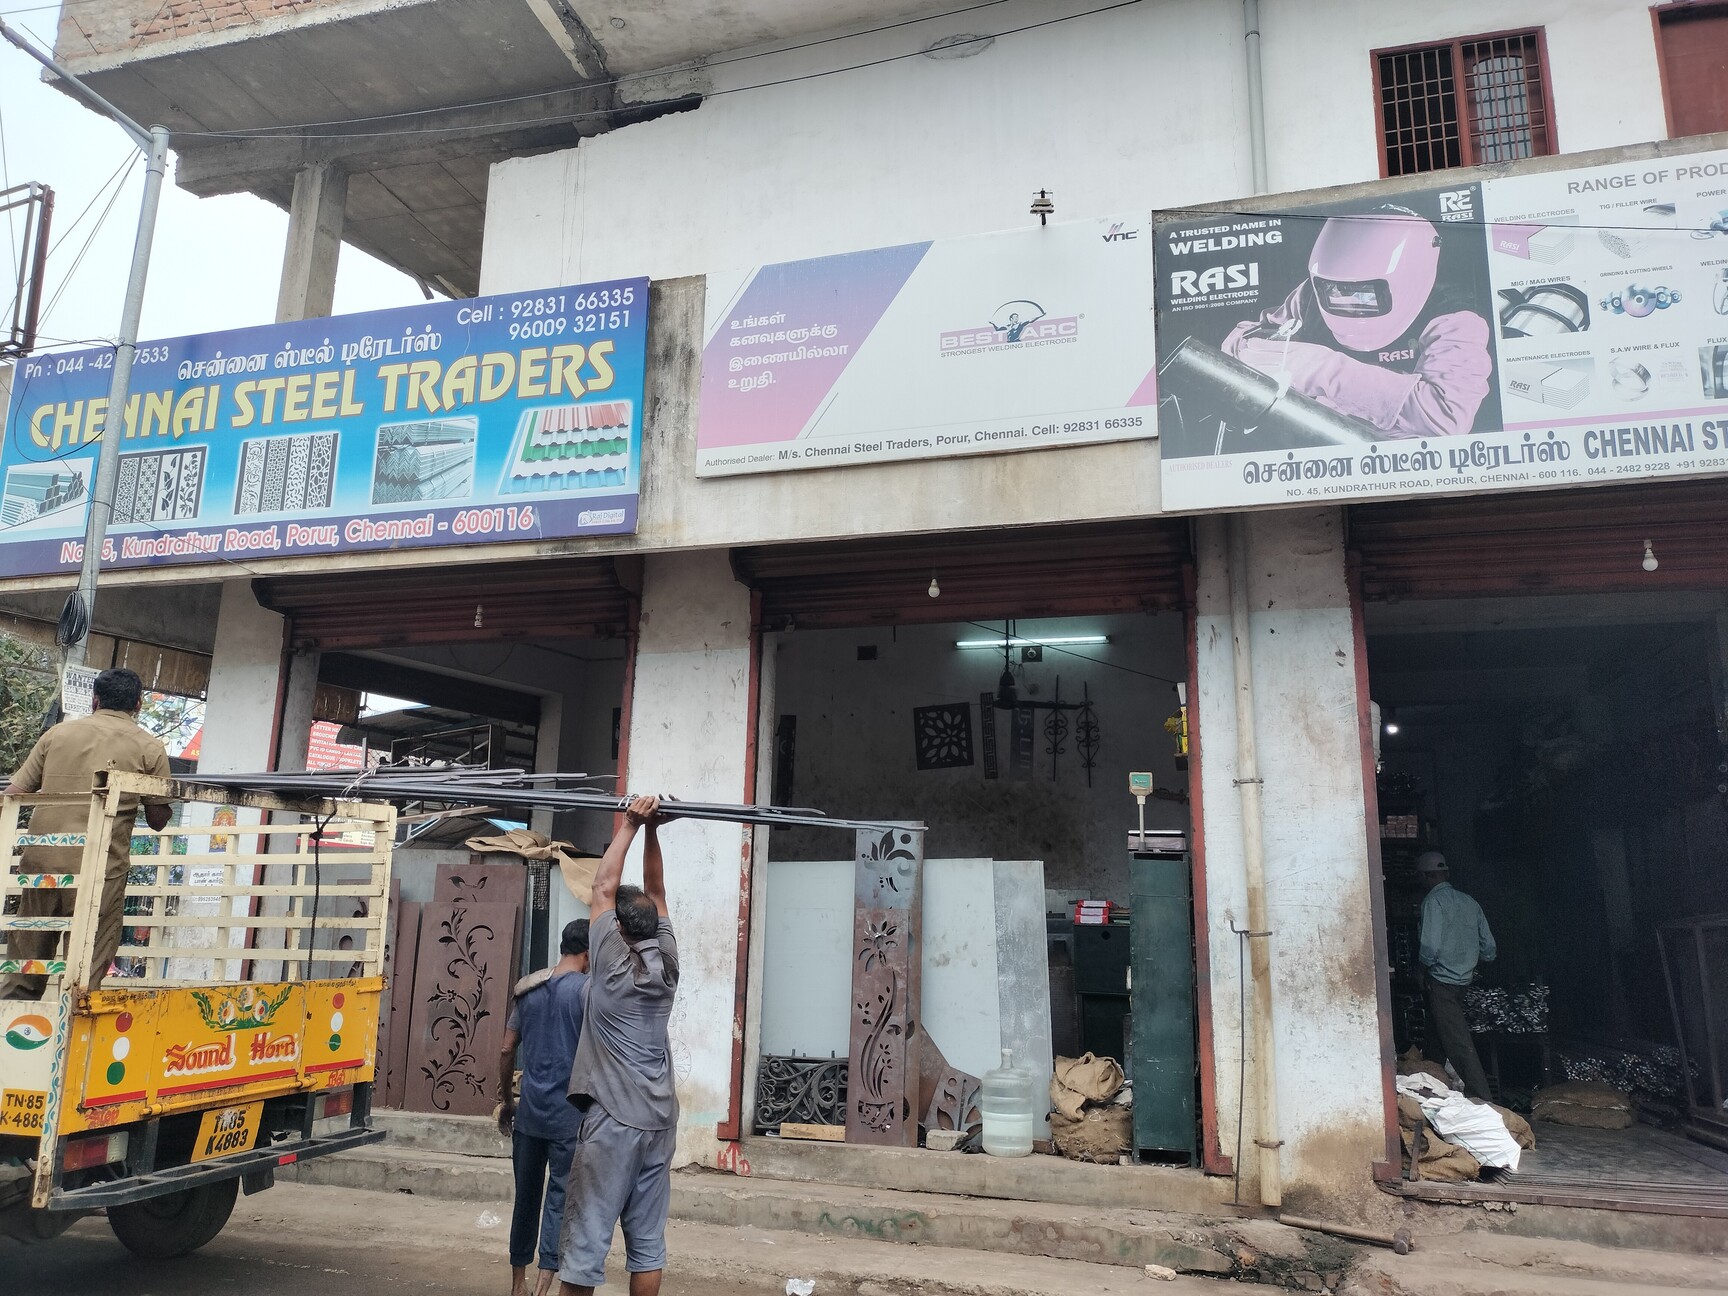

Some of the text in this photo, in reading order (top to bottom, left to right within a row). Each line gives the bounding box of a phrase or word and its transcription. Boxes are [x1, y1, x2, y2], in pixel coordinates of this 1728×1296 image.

[1567, 175, 1636, 195] RANGE
[1642, 170, 1669, 185] OF
[1615, 200, 1639, 209] FILLER
[1639, 198, 1658, 206] WIRE
[1696, 189, 1727, 198] POWER
[1493, 208, 1575, 223] WELDING ELECTRODES
[1169, 231, 1178, 239] A
[1179, 225, 1230, 238] TRUSTED
[1232, 220, 1266, 231] NAME
[1169, 231, 1283, 256] WELDING
[1500, 240, 1520, 251] RASI
[1599, 270, 1625, 278] GRINDING
[1629, 267, 1651, 275] CUTTING
[1651, 265, 1673, 273] WHEELS
[1700, 259, 1728, 267] WELDIN
[1170, 262, 1259, 296] RASI
[1547, 275, 1571, 283] WIRES
[457, 304, 493, 325] Cell
[511, 296, 566, 319] 92831
[574, 287, 635, 311] 66335
[1170, 290, 1259, 305] WELDING ELECTRODES
[1225, 298, 1258, 307] COMPANY
[509, 310, 630, 340] 96009 32151
[730, 311, 787, 330] உங்கள்
[729, 323, 838, 346] கனவுகளுக்கு
[941, 322, 1077, 349] BEST ARC
[1707, 336, 1728, 344] FLUX
[177, 324, 442, 381] சென்னை ஸ்டீல் டிரேடர்ஸ்
[940, 337, 1078, 358] STRONGEST WELDING ELECTRODES
[1378, 349, 1414, 362] RASI
[1506, 350, 1591, 363] MAINTENANCE ELECTRODES
[1632, 344, 1652, 352] WIRE
[1660, 341, 1680, 349] FLUX
[56, 356, 84, 375] 044
[728, 344, 849, 372] இணையில்லா
[727, 371, 777, 392] உறுதி.
[1510, 380, 1531, 391] RASI
[30, 340, 615, 452] CHENNAI STEEL TRADERS
[705, 416, 1143, 467] Authorised Dealer: M/s. Chennai Steel Traders, Porur, Chennai. Cell: 92831 66335
[1583, 423, 1695, 460] CHENNAI
[1168, 459, 1233, 473] AUTHORISED DEALERS
[1243, 451, 1354, 485] சென்னை
[1449, 430, 1571, 475] டிரேடர்ஸ்
[1286, 487, 1304, 497] NO.
[1307, 487, 1322, 497] 45,
[1323, 481, 1398, 494] KUNDRATHUR
[1399, 478, 1433, 489] ROAD,
[1436, 476, 1477, 487] PORUR,
[1479, 472, 1529, 483] CHENNAI
[1538, 470, 1557, 479] 600
[1560, 468, 1582, 478] 116.
[1587, 466, 1607, 476] 044
[1616, 464, 1642, 474] 2482
[1644, 462, 1671, 472] 9228
[1676, 460, 1695, 469] +91
[122, 532, 222, 559] Kundrathur
[224, 525, 281, 551] Road,
[285, 524, 341, 548] Porur,
[345, 514, 435, 544] Chennai
[452, 505, 534, 534] 600116
[163, 1032, 299, 1076] Sound Horn
[204, 1128, 249, 1156] K4883
